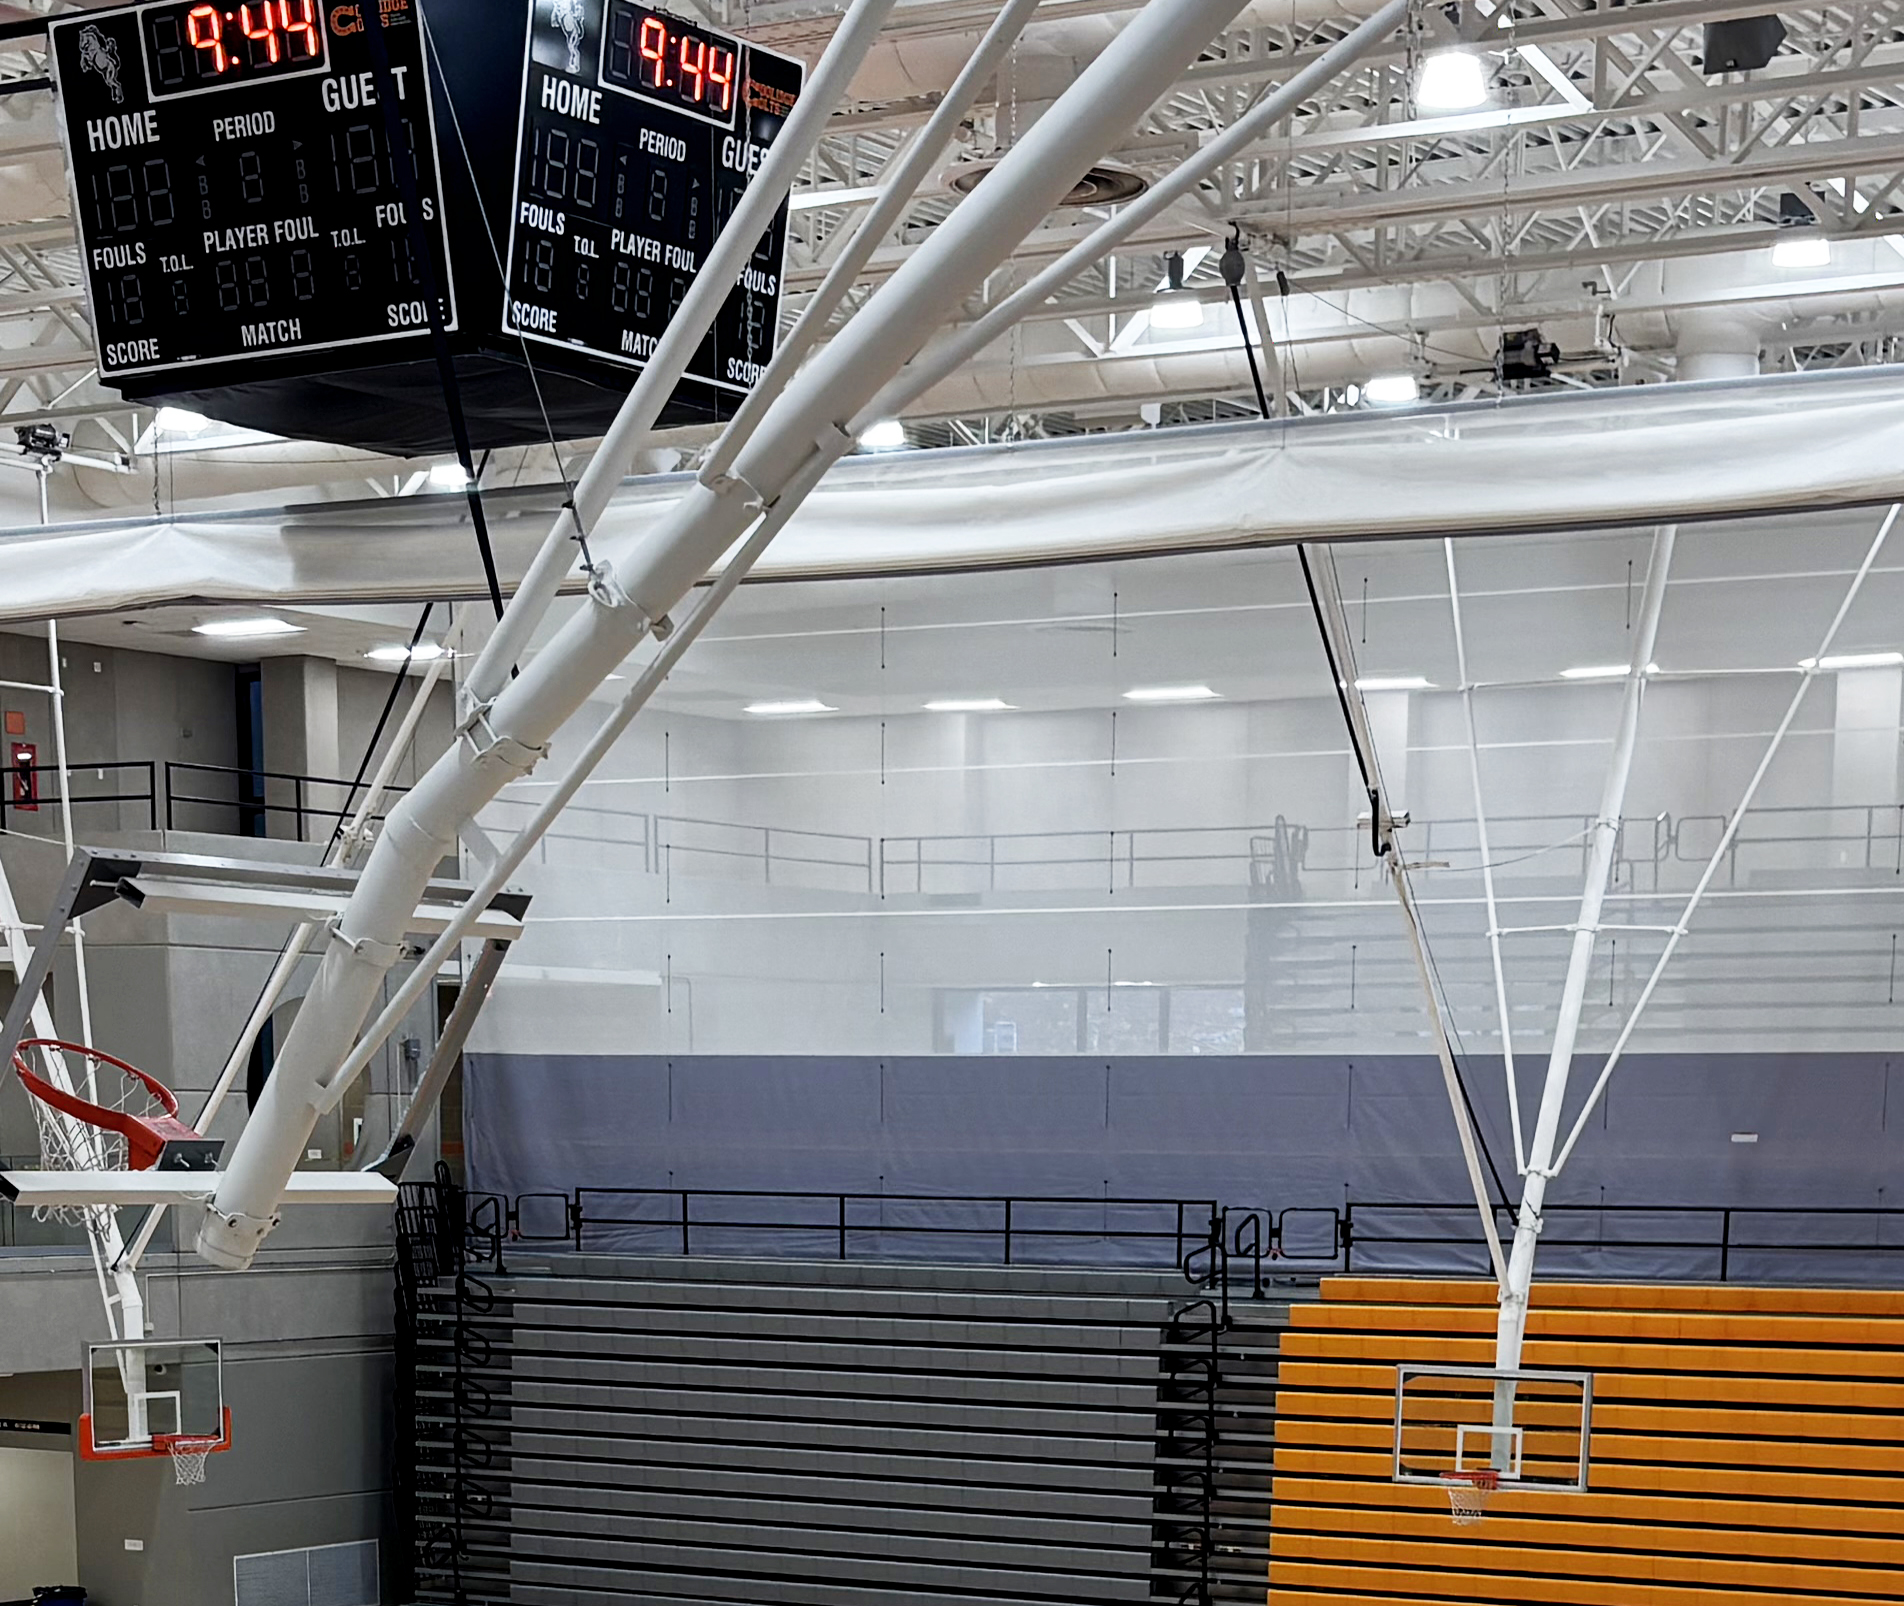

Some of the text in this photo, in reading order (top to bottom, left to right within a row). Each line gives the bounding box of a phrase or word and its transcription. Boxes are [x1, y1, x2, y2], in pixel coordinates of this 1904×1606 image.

[188, 0, 316, 72] 9:44
[640, 17, 732, 111] 9:44
[321, 66, 408, 113] GUET
[541, 74, 603, 124] HOME
[87, 110, 160, 152] HOME
[213, 111, 275, 141] PERIOD
[639, 128, 686, 162] PERIOD
[722, 136, 769, 175] GUE
[376, 197, 434, 228] FOS
[519, 201, 565, 235] FOULS
[203, 216, 319, 253] PLAYER FOUL
[611, 228, 696, 273] PLAYER FOUL
[93, 242, 146, 270] FOULS
[159, 253, 194, 273] T.O.L.
[387, 298, 445, 327] SCO
[511, 300, 557, 333] SCORE
[241, 318, 301, 347] MATCH
[621, 329, 657, 357] MATC
[106, 338, 160, 366] SCORE
